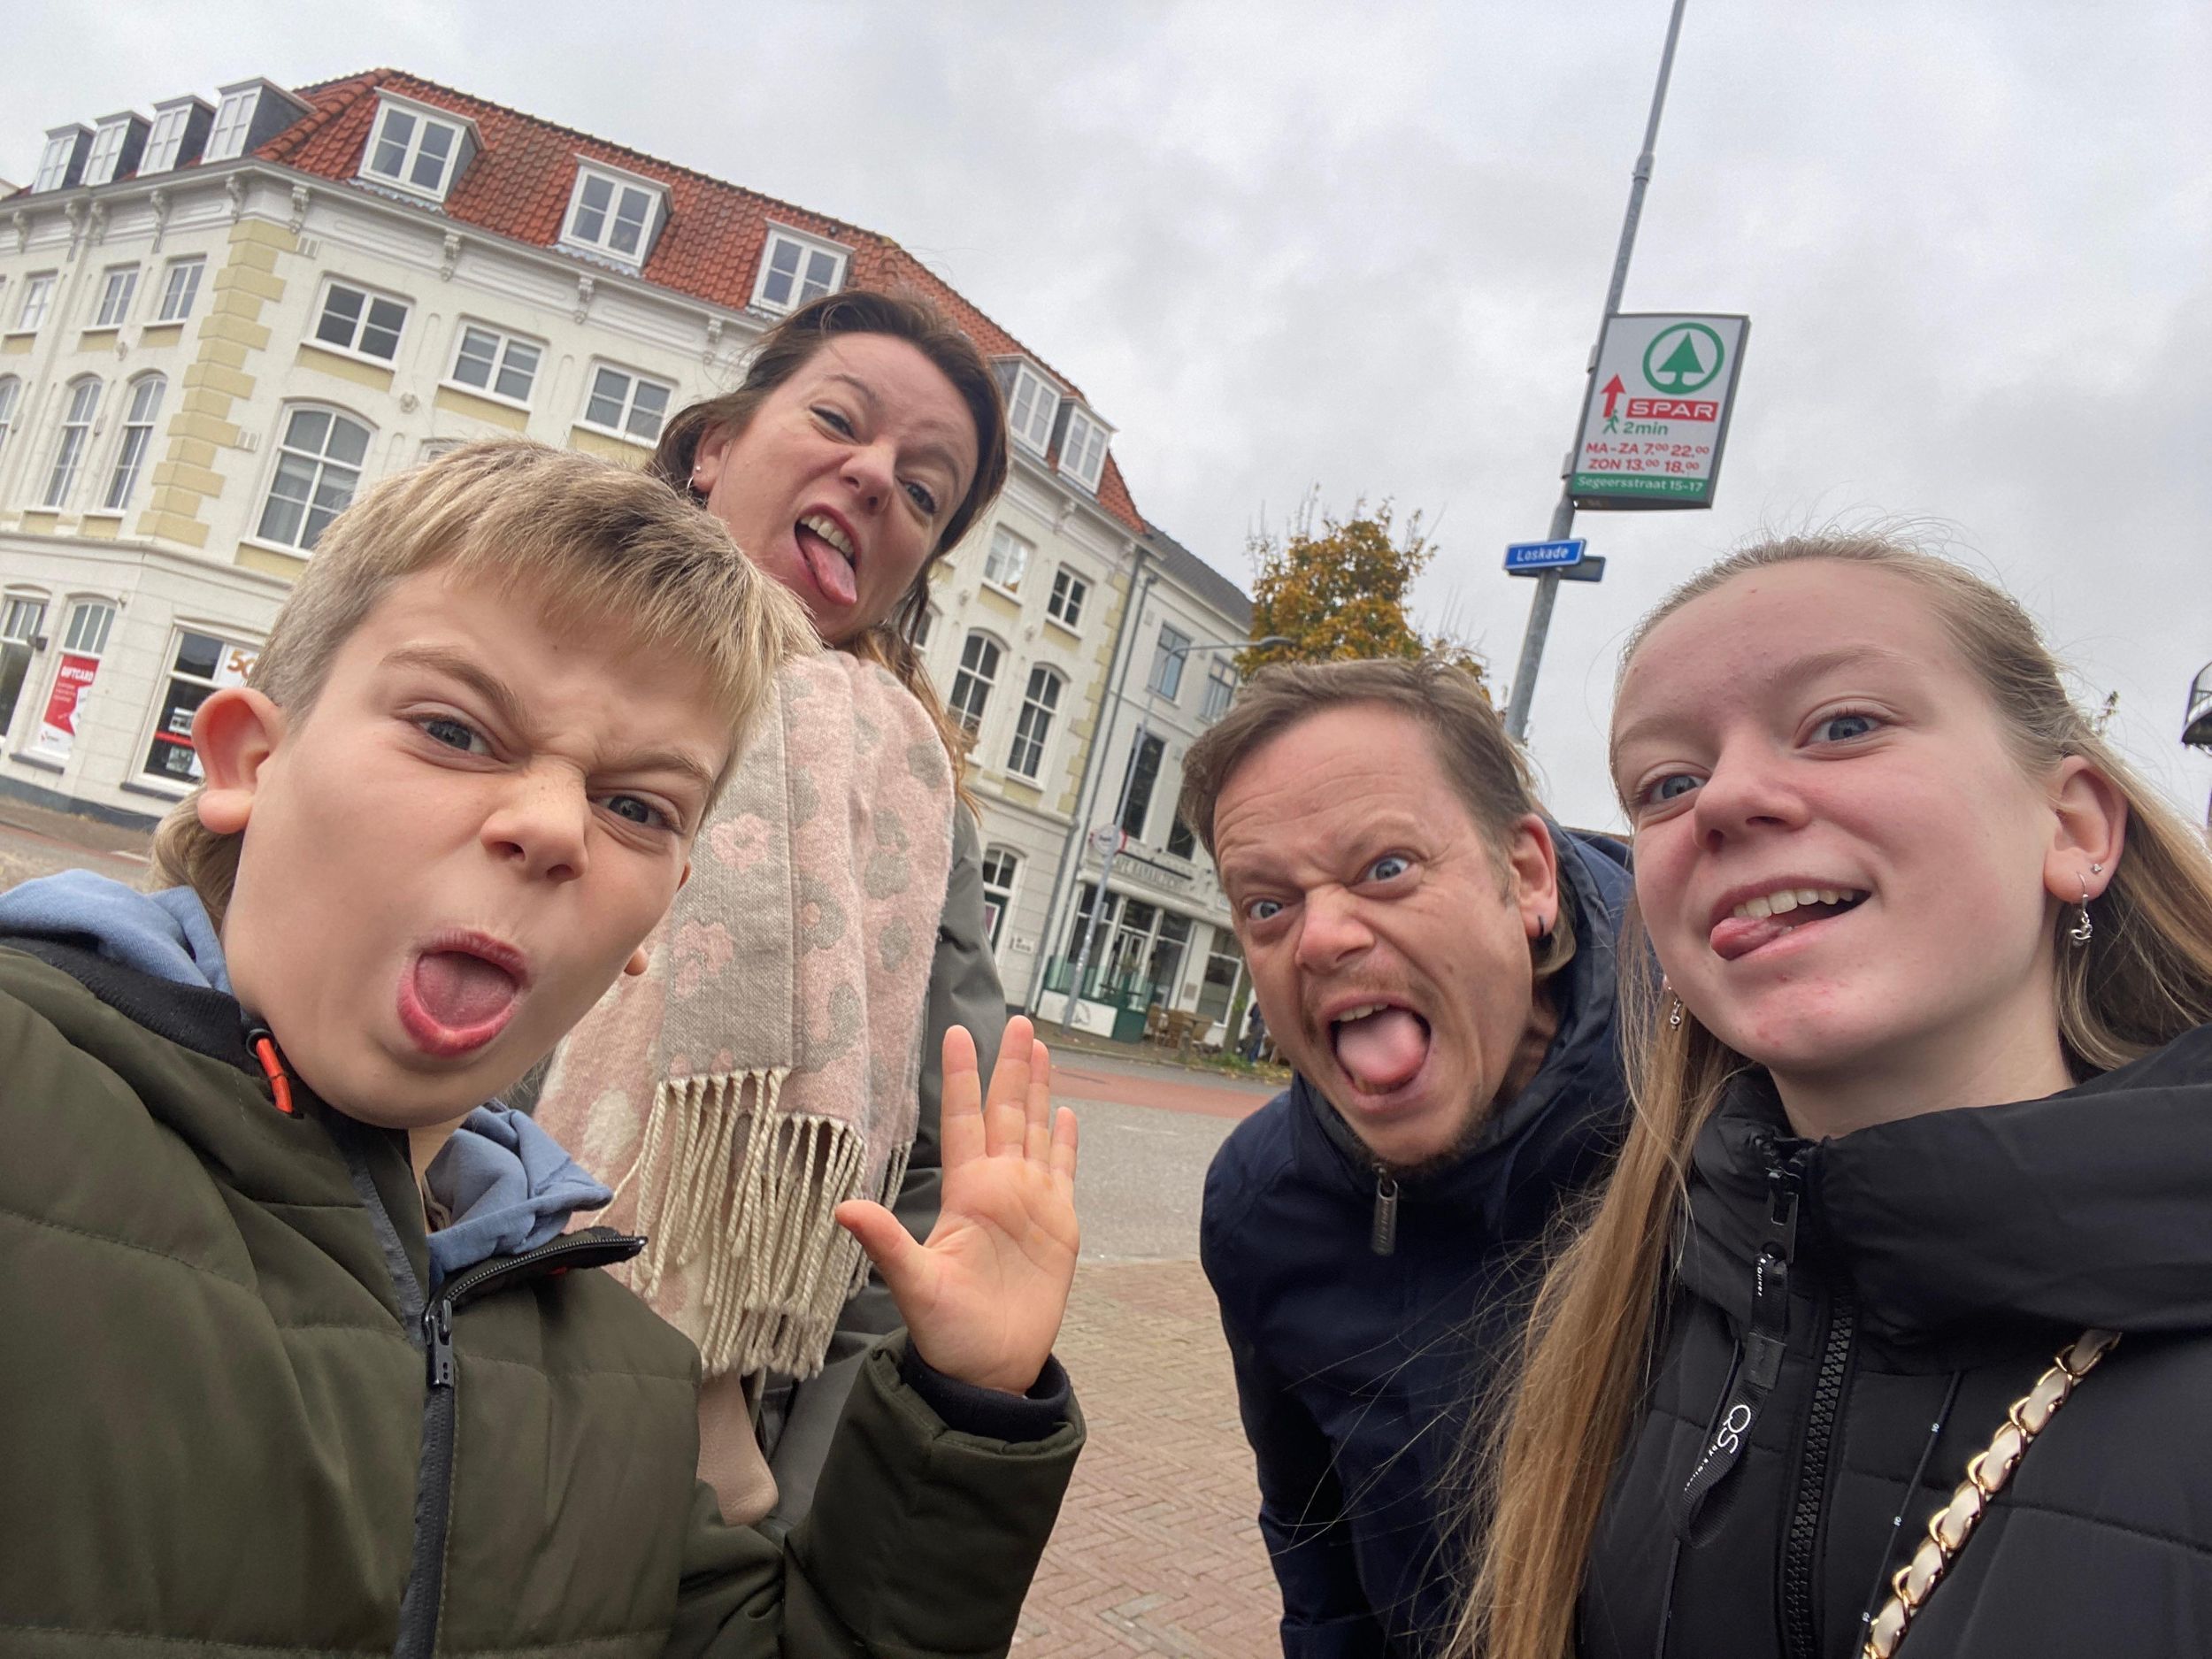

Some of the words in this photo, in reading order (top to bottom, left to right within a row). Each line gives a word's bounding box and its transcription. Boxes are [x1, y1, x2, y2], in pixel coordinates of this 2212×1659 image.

[1631, 400, 1714, 419] SPAR
[1671, 444, 1709, 458] 22.00
[1588, 458, 1621, 470] ZON
[1625, 458, 1660, 472] 13.00
[1663, 460, 1700, 474] 18.00
[1578, 476, 1666, 490] Segeersstraat
[1670, 480, 1703, 492] 15-17
[1516, 545, 1570, 562] Loskade
[1717, 1404, 1751, 1454] QS
